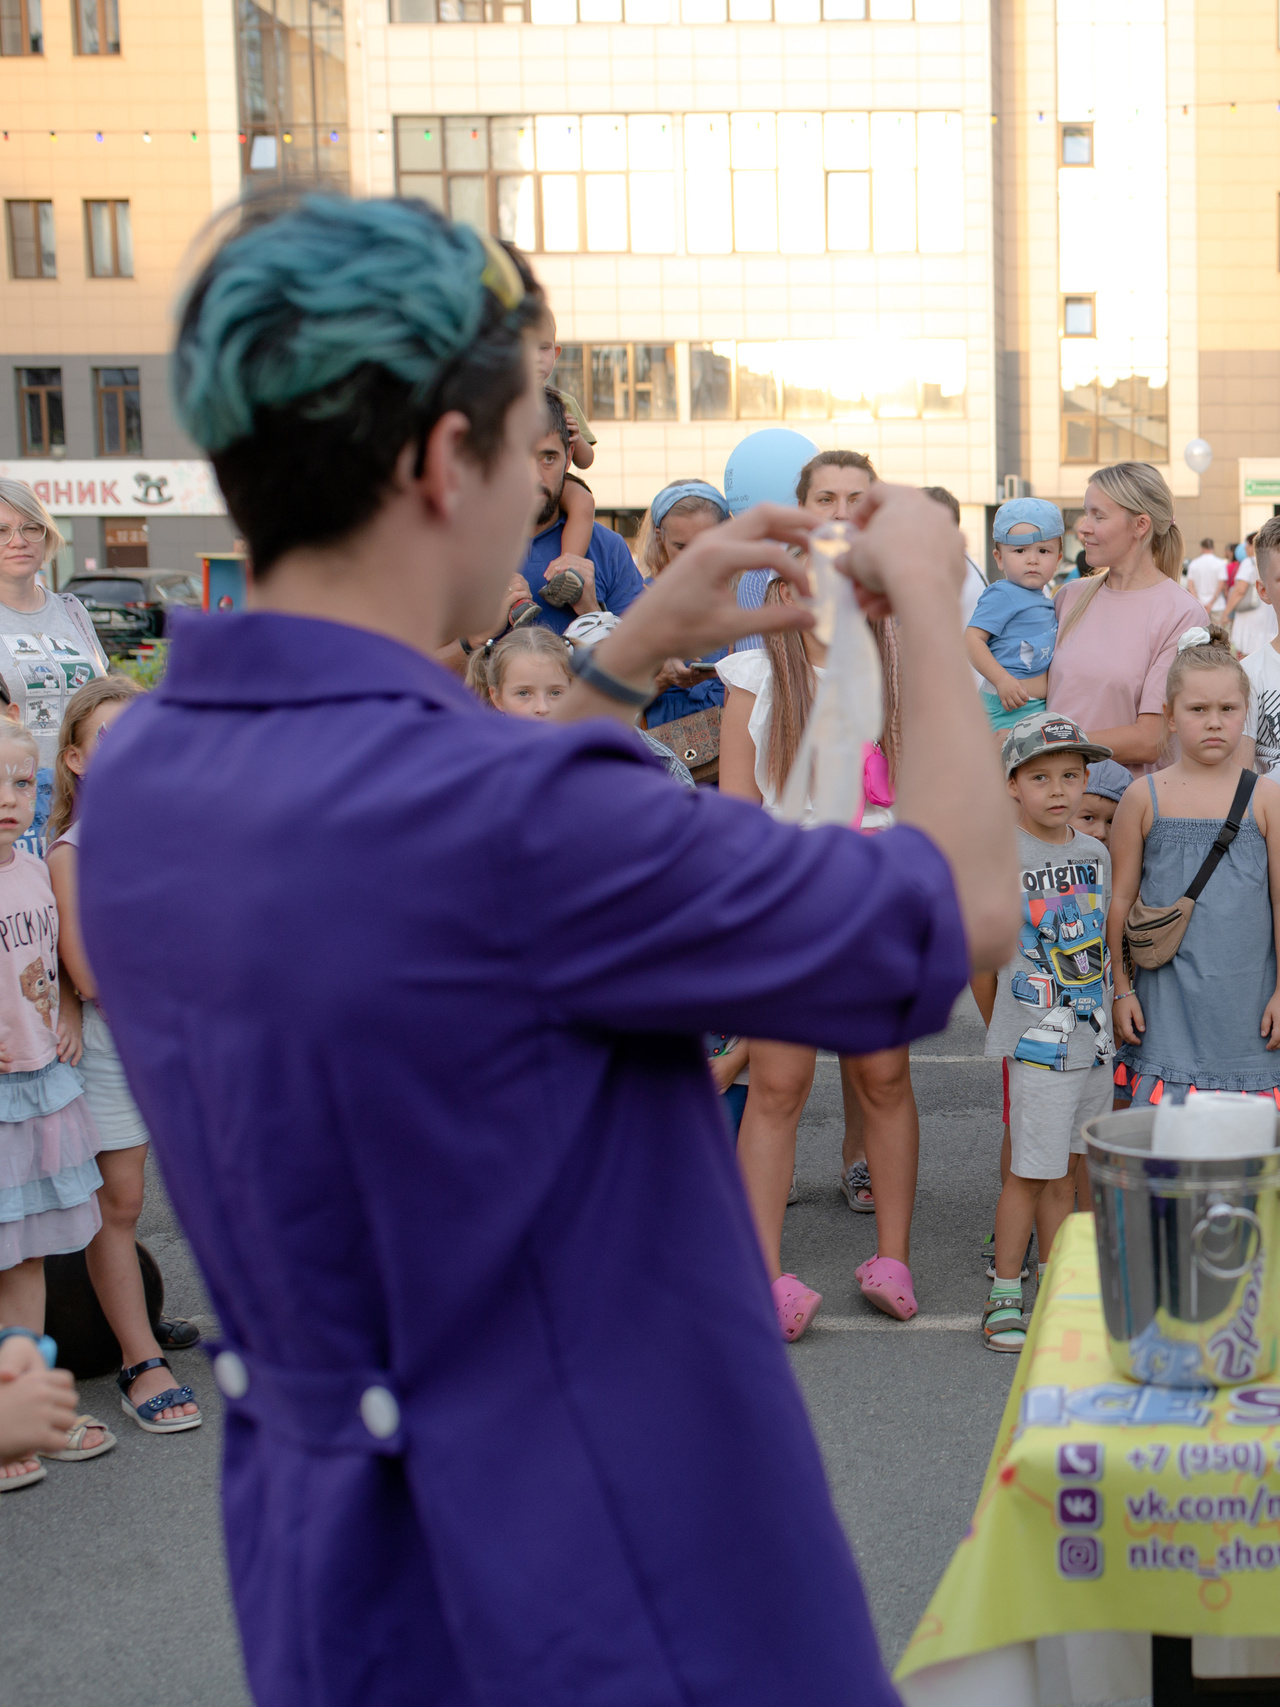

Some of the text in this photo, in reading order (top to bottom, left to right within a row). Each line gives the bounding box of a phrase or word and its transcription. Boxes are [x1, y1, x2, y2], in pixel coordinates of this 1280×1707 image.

[19, 479, 122, 505] ЯНИК
[1127, 1442, 1170, 1473] +7
[1178, 1441, 1266, 1480] (950)
